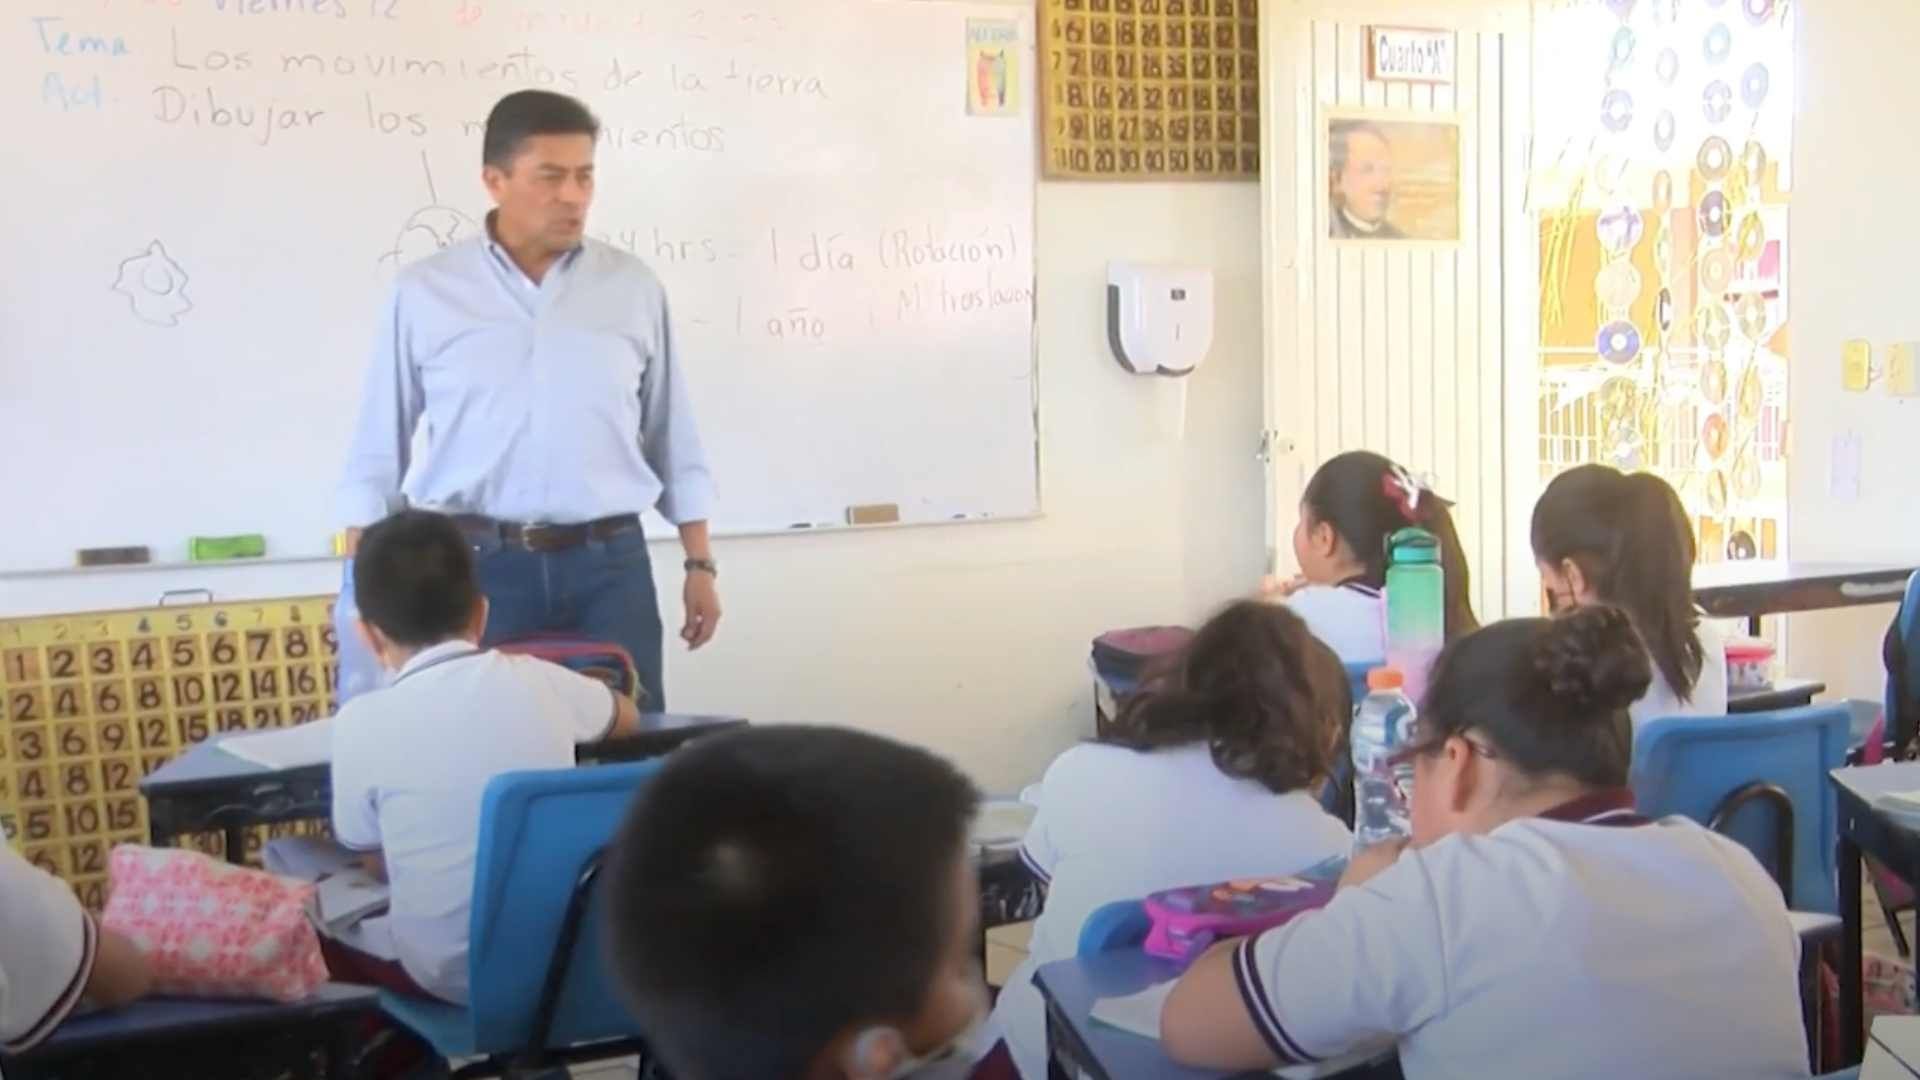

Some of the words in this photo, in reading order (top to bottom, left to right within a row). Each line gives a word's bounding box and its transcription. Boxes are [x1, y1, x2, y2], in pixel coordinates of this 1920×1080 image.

[1065, 20, 1083, 43] 6
[31, 15, 132, 55] Tema
[168, 24, 253, 71] Los
[279, 46, 579, 92] movimientos
[602, 56, 645, 93] de
[671, 62, 707, 93] la
[1066, 50, 1082, 76] 7
[1117, 53, 1134, 78] 21
[1378, 33, 1424, 73] Cuarto
[1067, 82, 1083, 108] 8
[152, 83, 326, 146] Dibujar
[366, 88, 428, 136] los
[1070, 115, 1084, 140] 9
[1119, 117, 1138, 141] 27
[1069, 148, 1089, 172] 10
[1095, 148, 1115, 173] 20
[799, 231, 854, 271] día
[767, 306, 825, 339] año
[137, 617, 151, 633] 4
[176, 614, 193, 632] 5
[214, 610, 228, 627] 6
[253, 606, 265, 622] 7
[16, 653, 25, 681] 1
[53, 649, 76, 678] 2
[93, 647, 115, 674] 3
[131, 643, 154, 671] 4
[171, 639, 195, 667] 5
[212, 634, 237, 665] 6
[247, 632, 272, 661] 7
[286, 628, 308, 659] 8
[14, 692, 37, 722] 2
[56, 688, 78, 716] 4
[99, 685, 120, 714] 6
[140, 680, 161, 709] 8
[173, 675, 205, 705] 10
[212, 672, 242, 702] 12
[250, 668, 277, 699] 14
[287, 665, 317, 697] 16
[20, 730, 42, 760] 3
[62, 727, 86, 757] 6
[103, 722, 125, 752] 9
[138, 718, 167, 749] 12
[178, 713, 209, 744] 15
[23, 769, 46, 799] 4
[66, 765, 90, 796] 8
[102, 761, 132, 792] 12
[0, 814, 17, 840] 5
[27, 809, 51, 839] 5
[64, 803, 99, 836] 10
[107, 801, 137, 831] 15
[70, 842, 104, 875] 12
